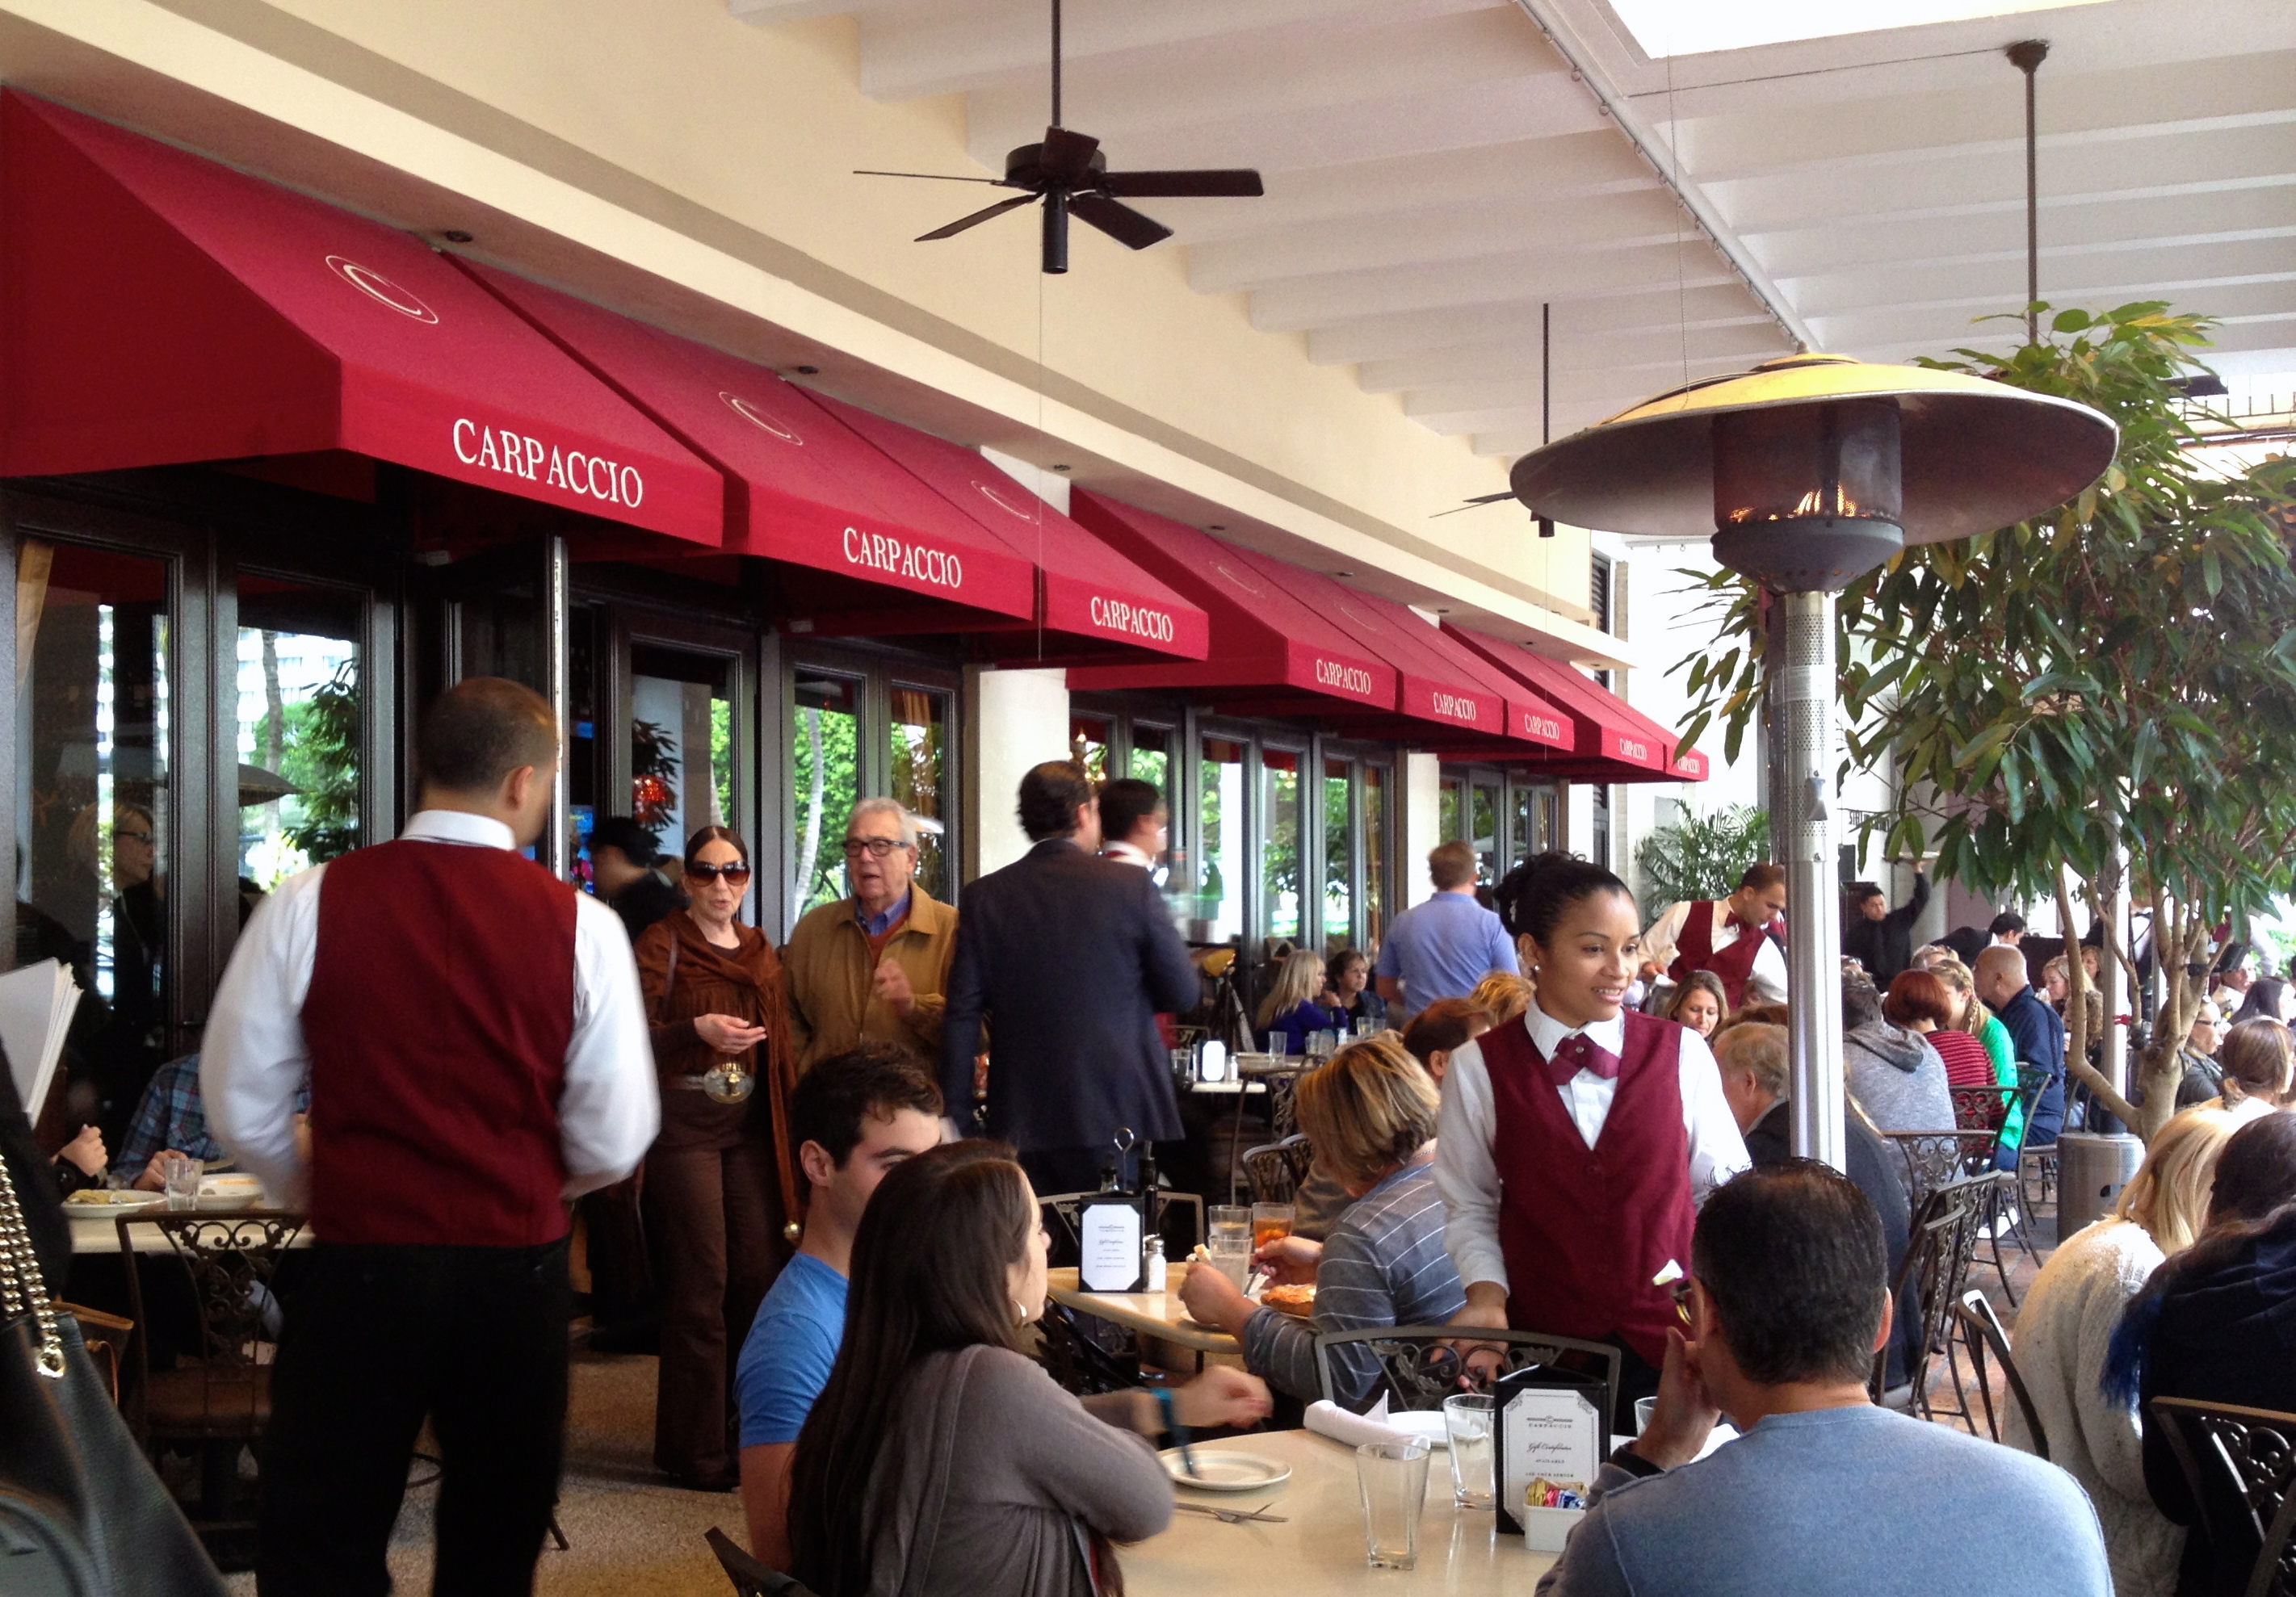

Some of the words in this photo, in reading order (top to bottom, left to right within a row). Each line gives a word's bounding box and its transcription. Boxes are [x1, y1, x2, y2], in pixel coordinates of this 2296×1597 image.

[453, 418, 643, 508] CARPACCIO
[844, 527, 961, 588] CARPACCIO
[1091, 597, 1173, 642] CARPACCIO
[1316, 659, 1370, 694] CARPACCIO
[1433, 693, 1475, 721] CARPACCIO
[1525, 714, 1559, 740] CARPACCIO
